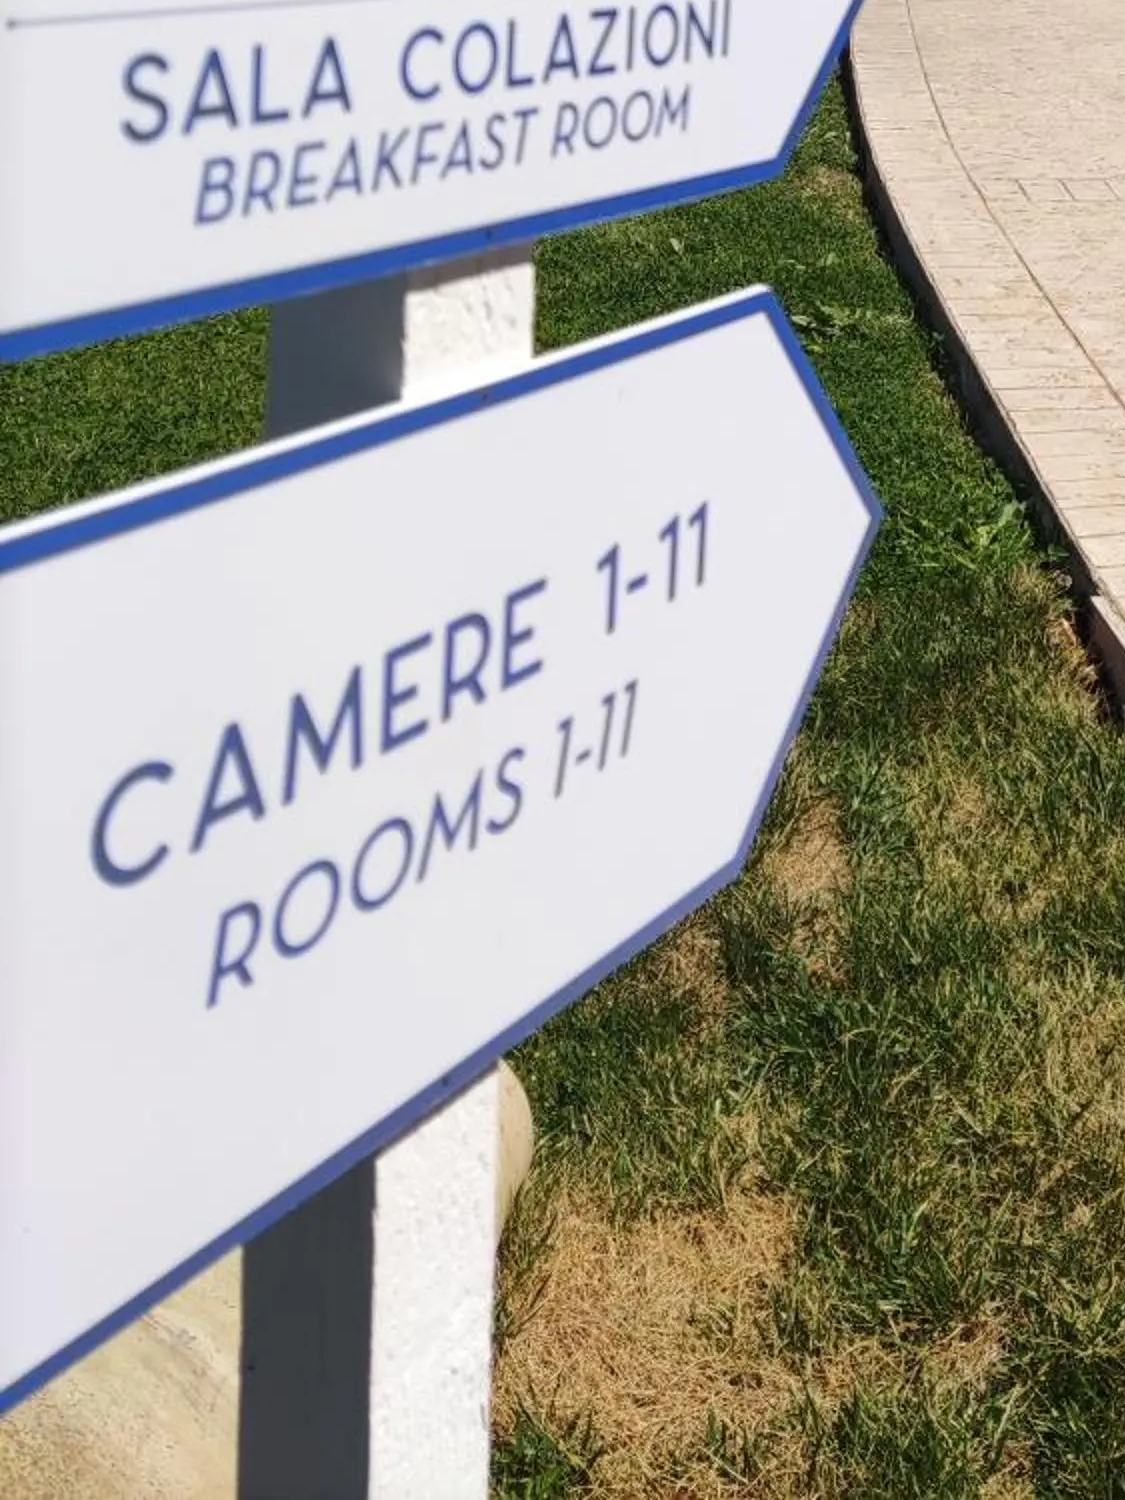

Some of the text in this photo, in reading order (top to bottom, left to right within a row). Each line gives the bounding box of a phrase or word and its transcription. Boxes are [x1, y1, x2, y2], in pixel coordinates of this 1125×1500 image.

[119, 34, 354, 147] SALA
[192, 85, 692, 227] BREAKFAST ROOM
[88, 499, 710, 890] CAMERE 1-11
[204, 677, 640, 1011] ROOMS 1-11
